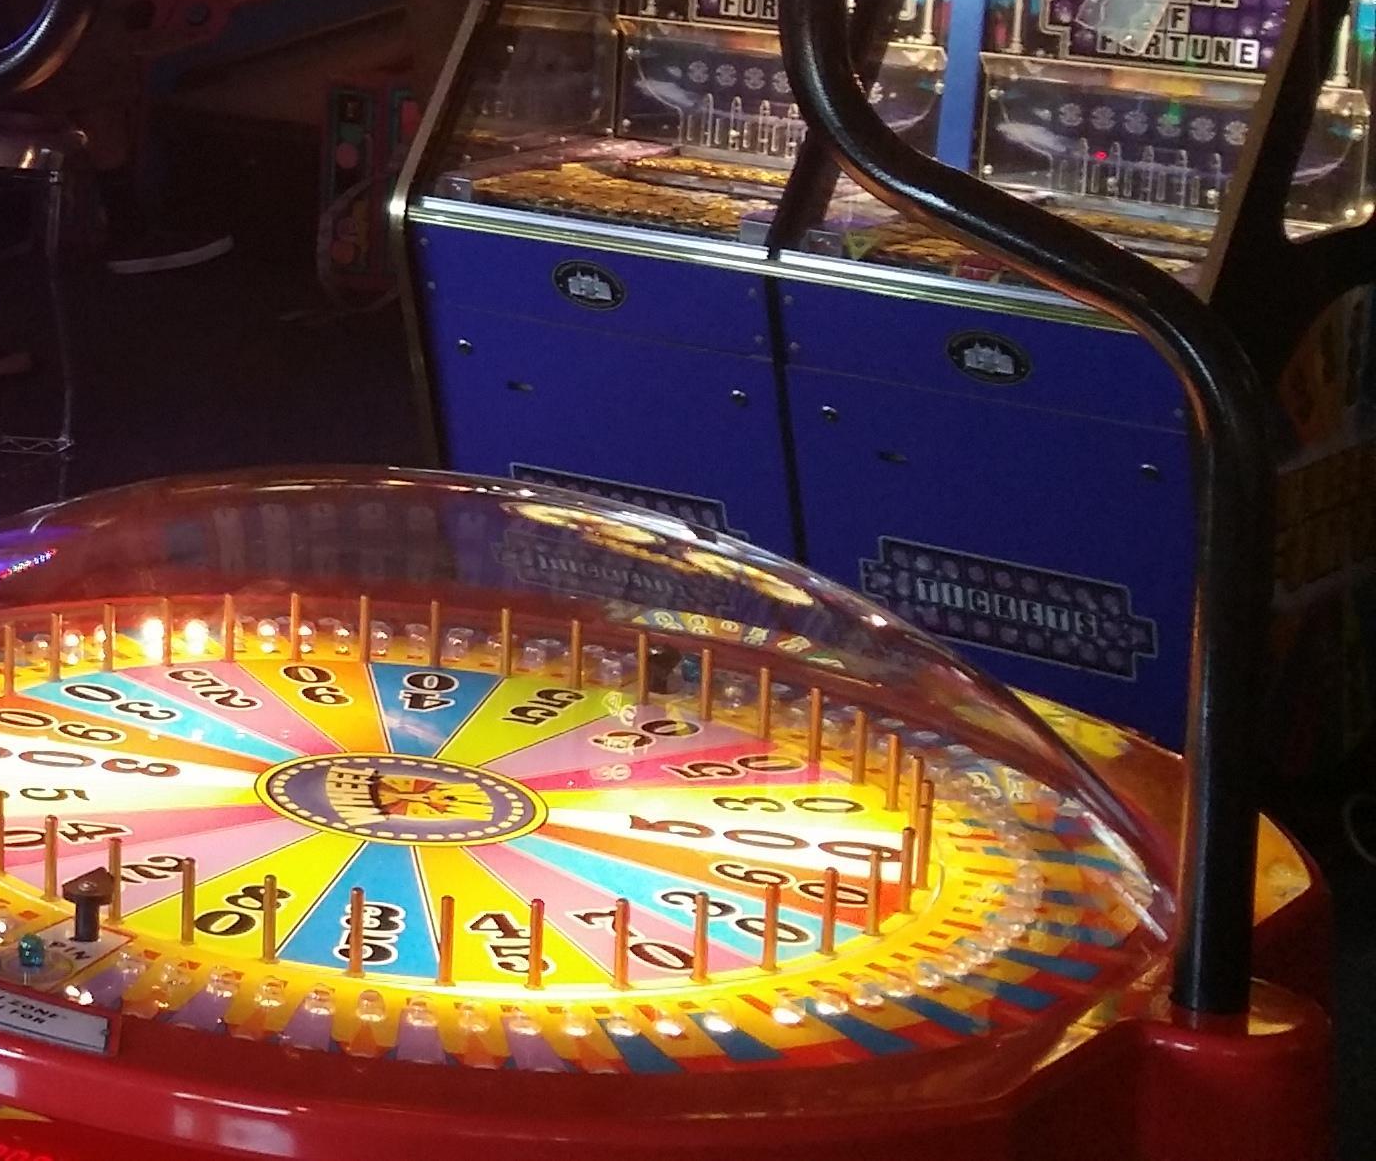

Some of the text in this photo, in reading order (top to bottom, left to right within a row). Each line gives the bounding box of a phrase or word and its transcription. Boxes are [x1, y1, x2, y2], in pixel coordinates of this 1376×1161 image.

[917, 576, 1098, 637] TICKETS
[50, 940, 92, 961] PIN
[469, 912, 550, 974] 45
[9, 1008, 47, 1024] FOR
